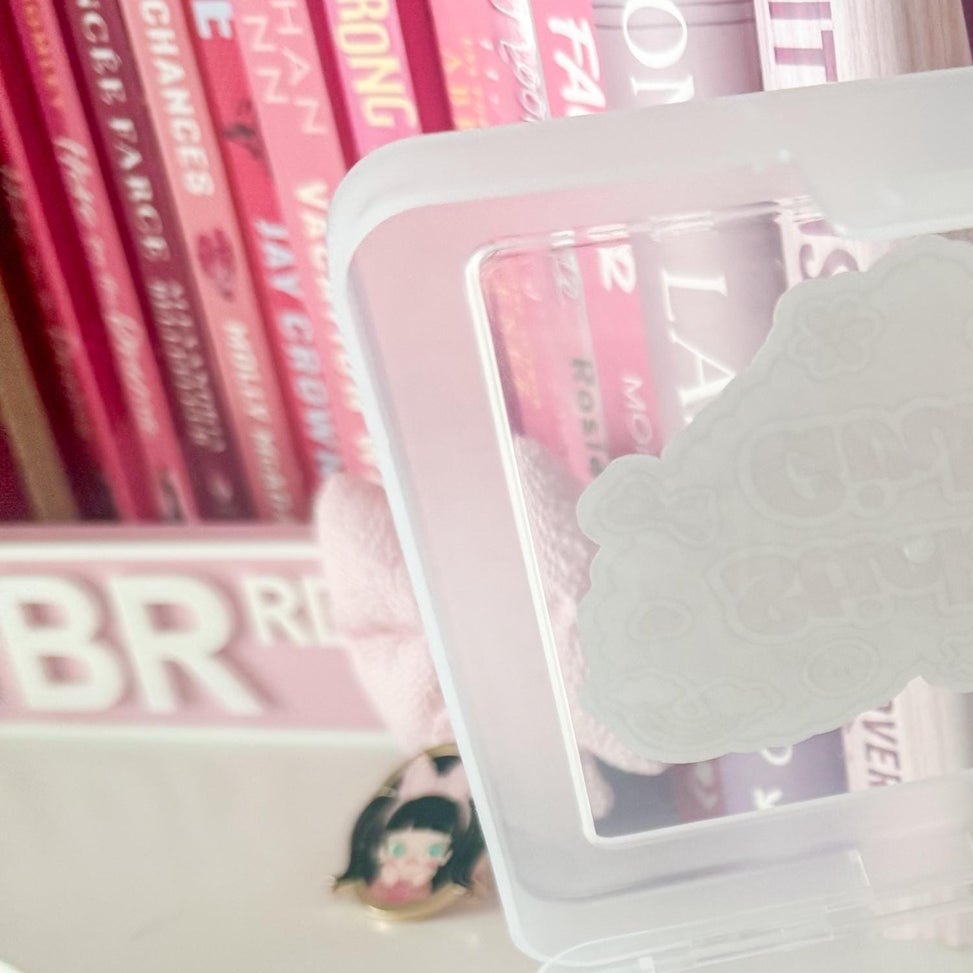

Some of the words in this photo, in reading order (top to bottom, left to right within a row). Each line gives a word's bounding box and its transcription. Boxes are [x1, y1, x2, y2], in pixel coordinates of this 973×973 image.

[141, 1, 215, 196] CHANCES
[547, 17, 607, 117] FA
[108, 117, 170, 260] FARCE
[255, 219, 304, 299] JAY
[661, 267, 738, 428] LA
